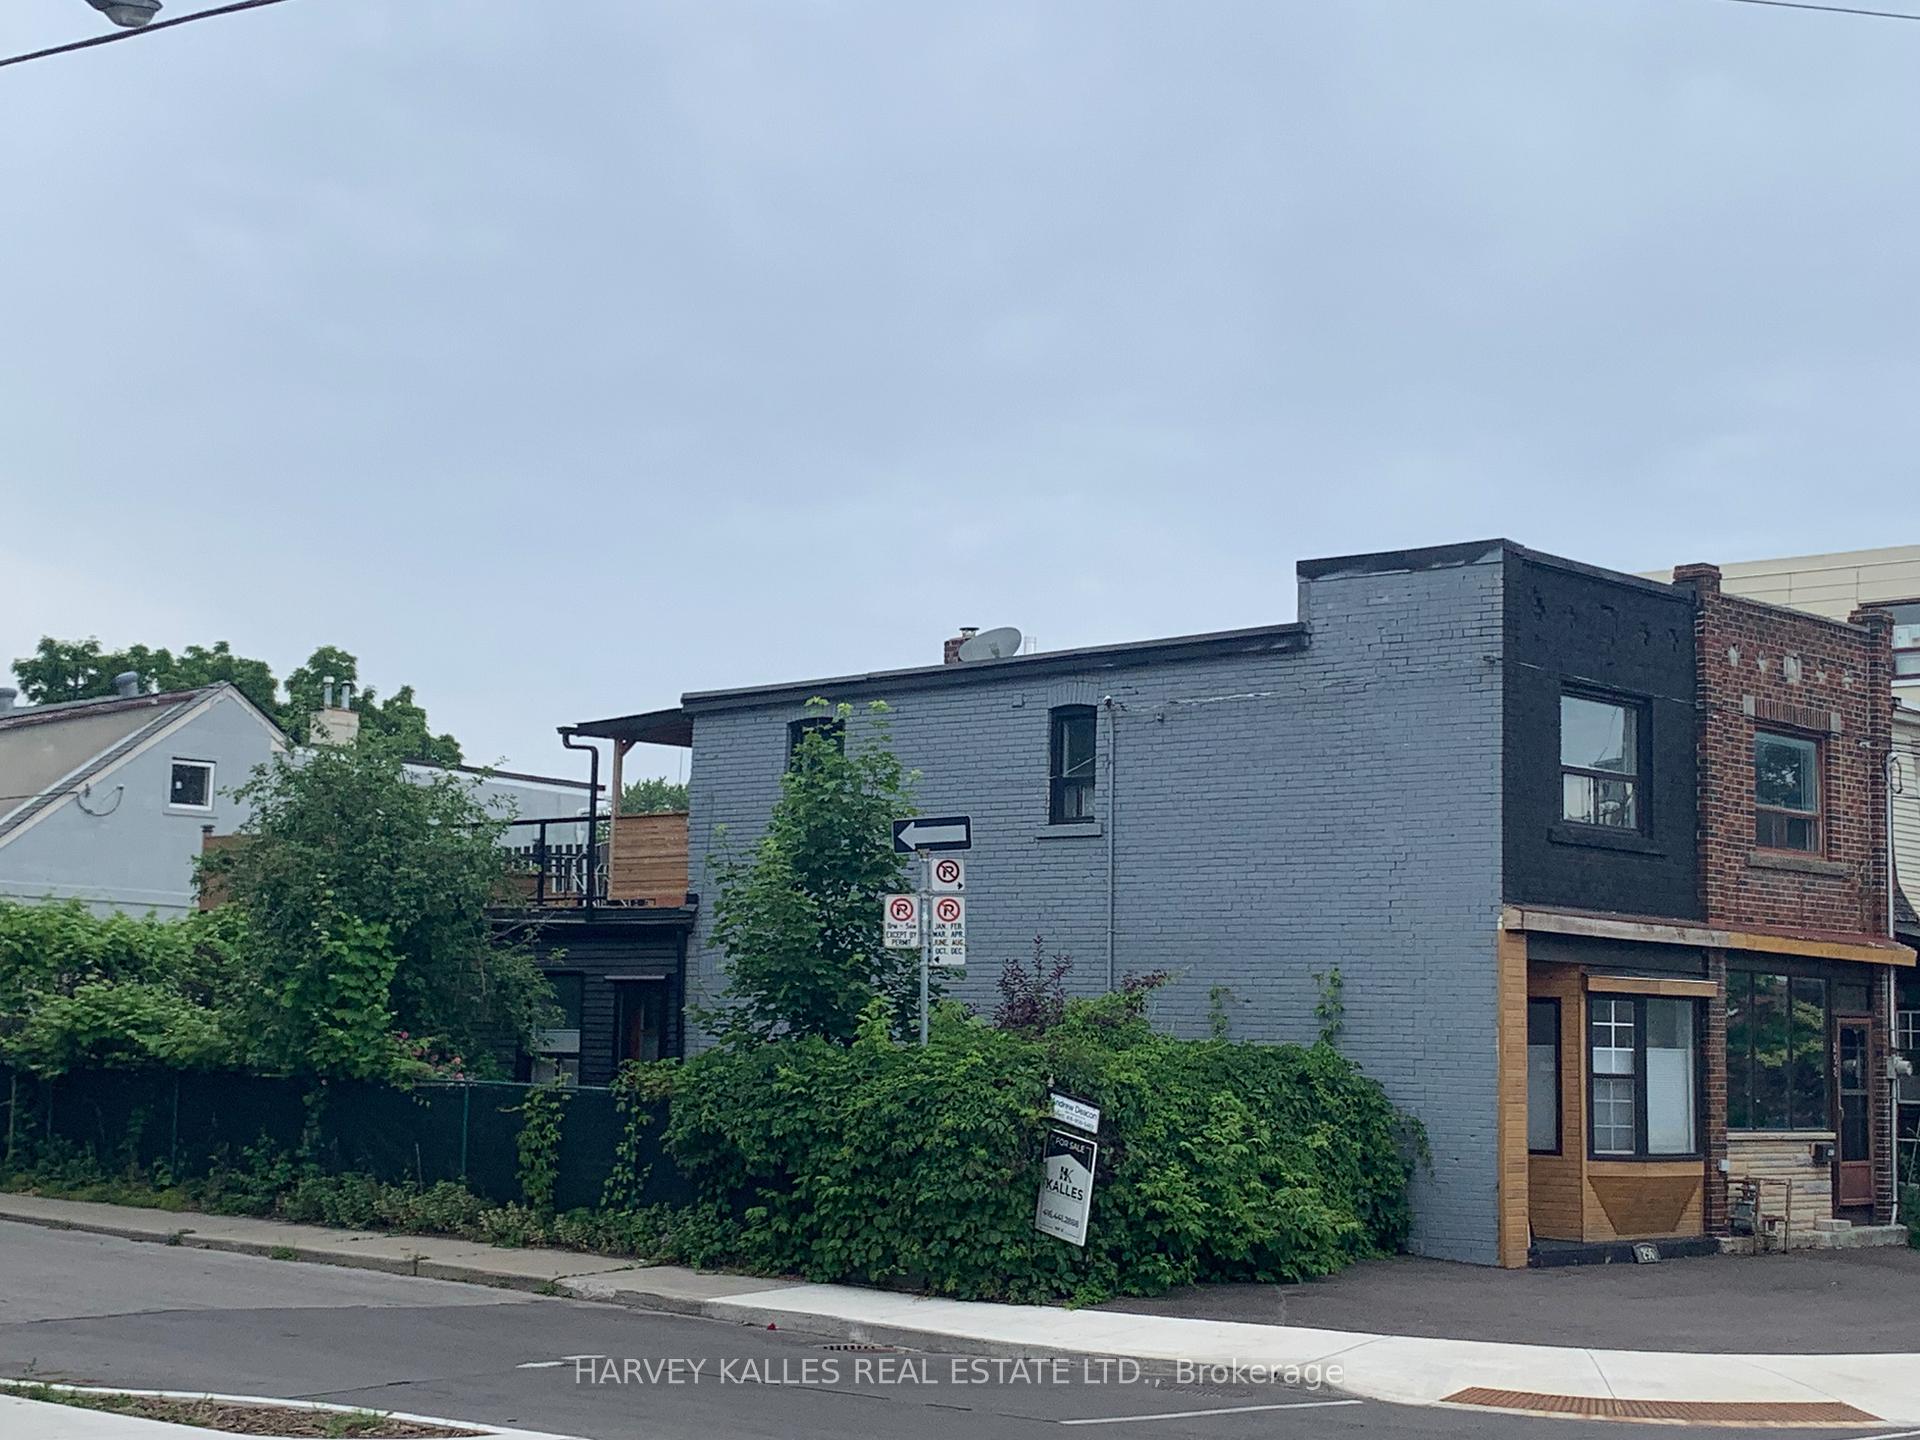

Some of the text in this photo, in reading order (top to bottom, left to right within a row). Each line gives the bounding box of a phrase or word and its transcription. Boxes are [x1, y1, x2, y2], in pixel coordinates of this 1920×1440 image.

[1055, 1137, 1085, 1154] FOR SALE
[1046, 1179, 1084, 1201] KALLES
